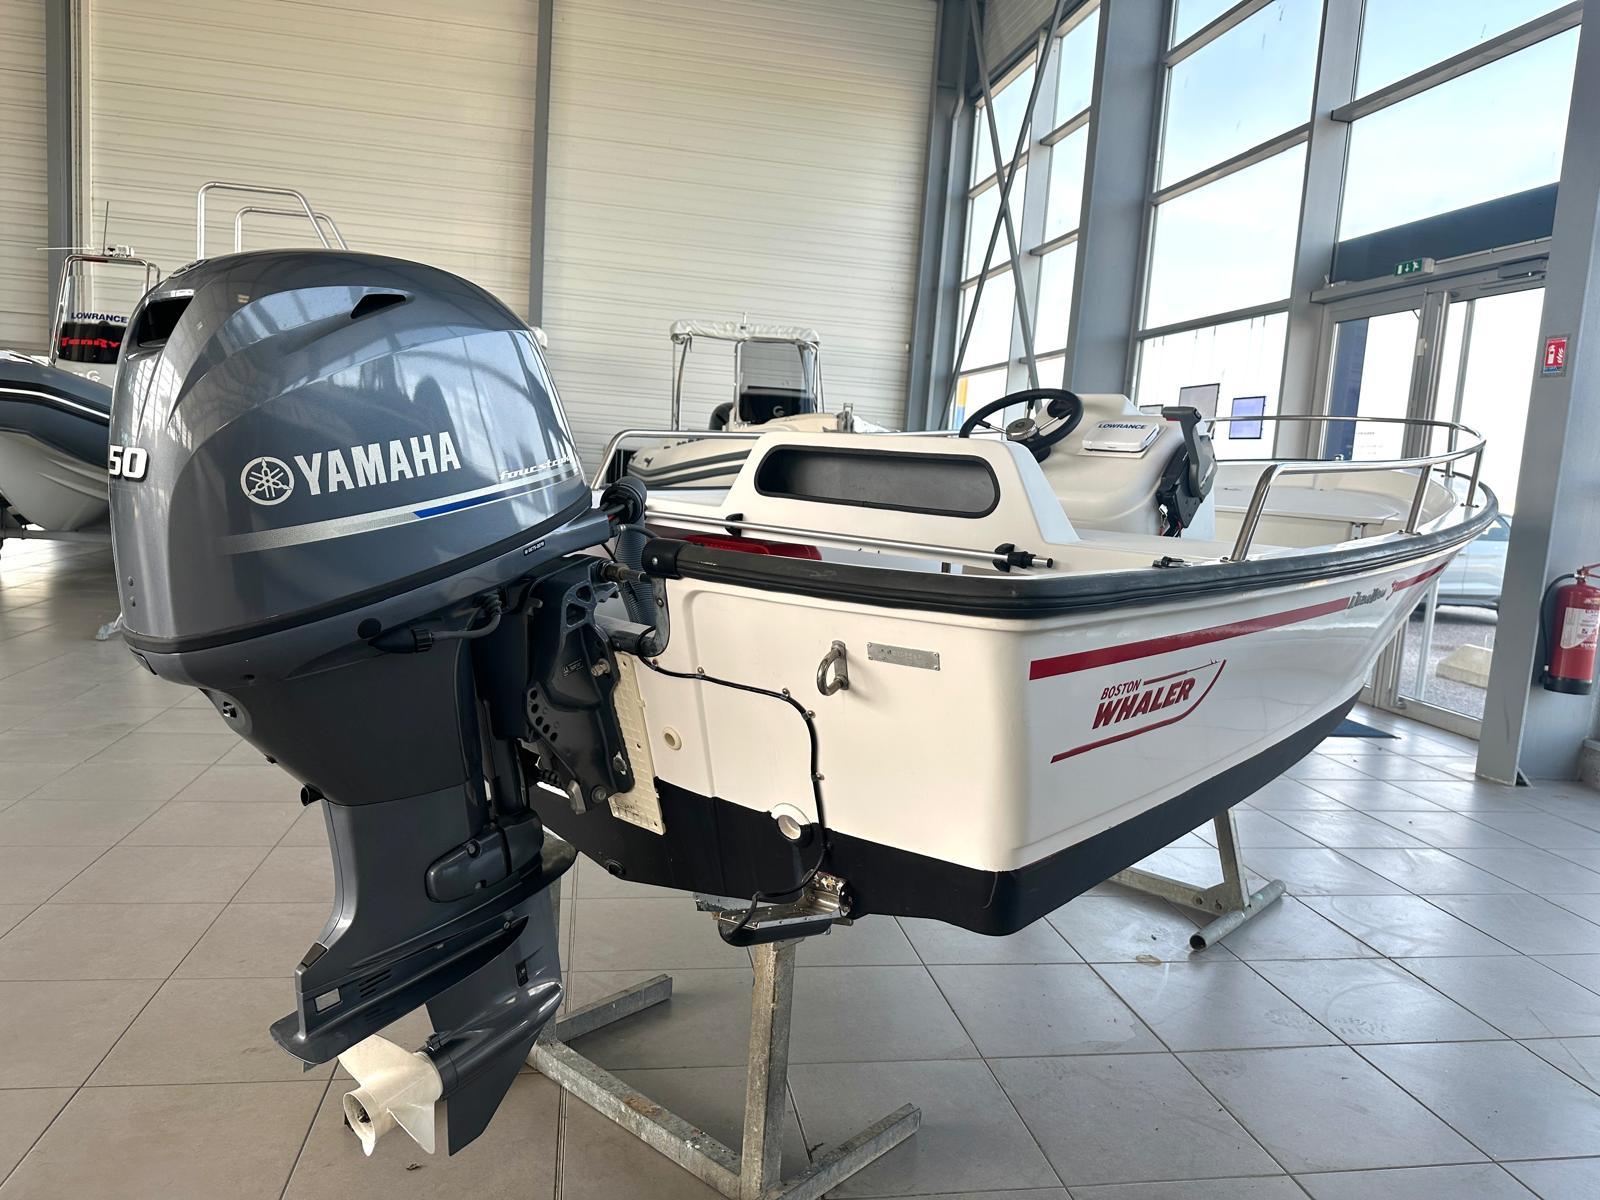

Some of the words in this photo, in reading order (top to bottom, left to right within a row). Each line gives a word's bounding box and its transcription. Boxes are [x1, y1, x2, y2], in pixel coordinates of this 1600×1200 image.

[71, 312, 129, 324] LOWRANCE
[109, 444, 148, 480] 50
[294, 431, 462, 496] YAMAHA
[1092, 677, 1196, 730] WHALER
[1100, 678, 1142, 701] BOSTON
